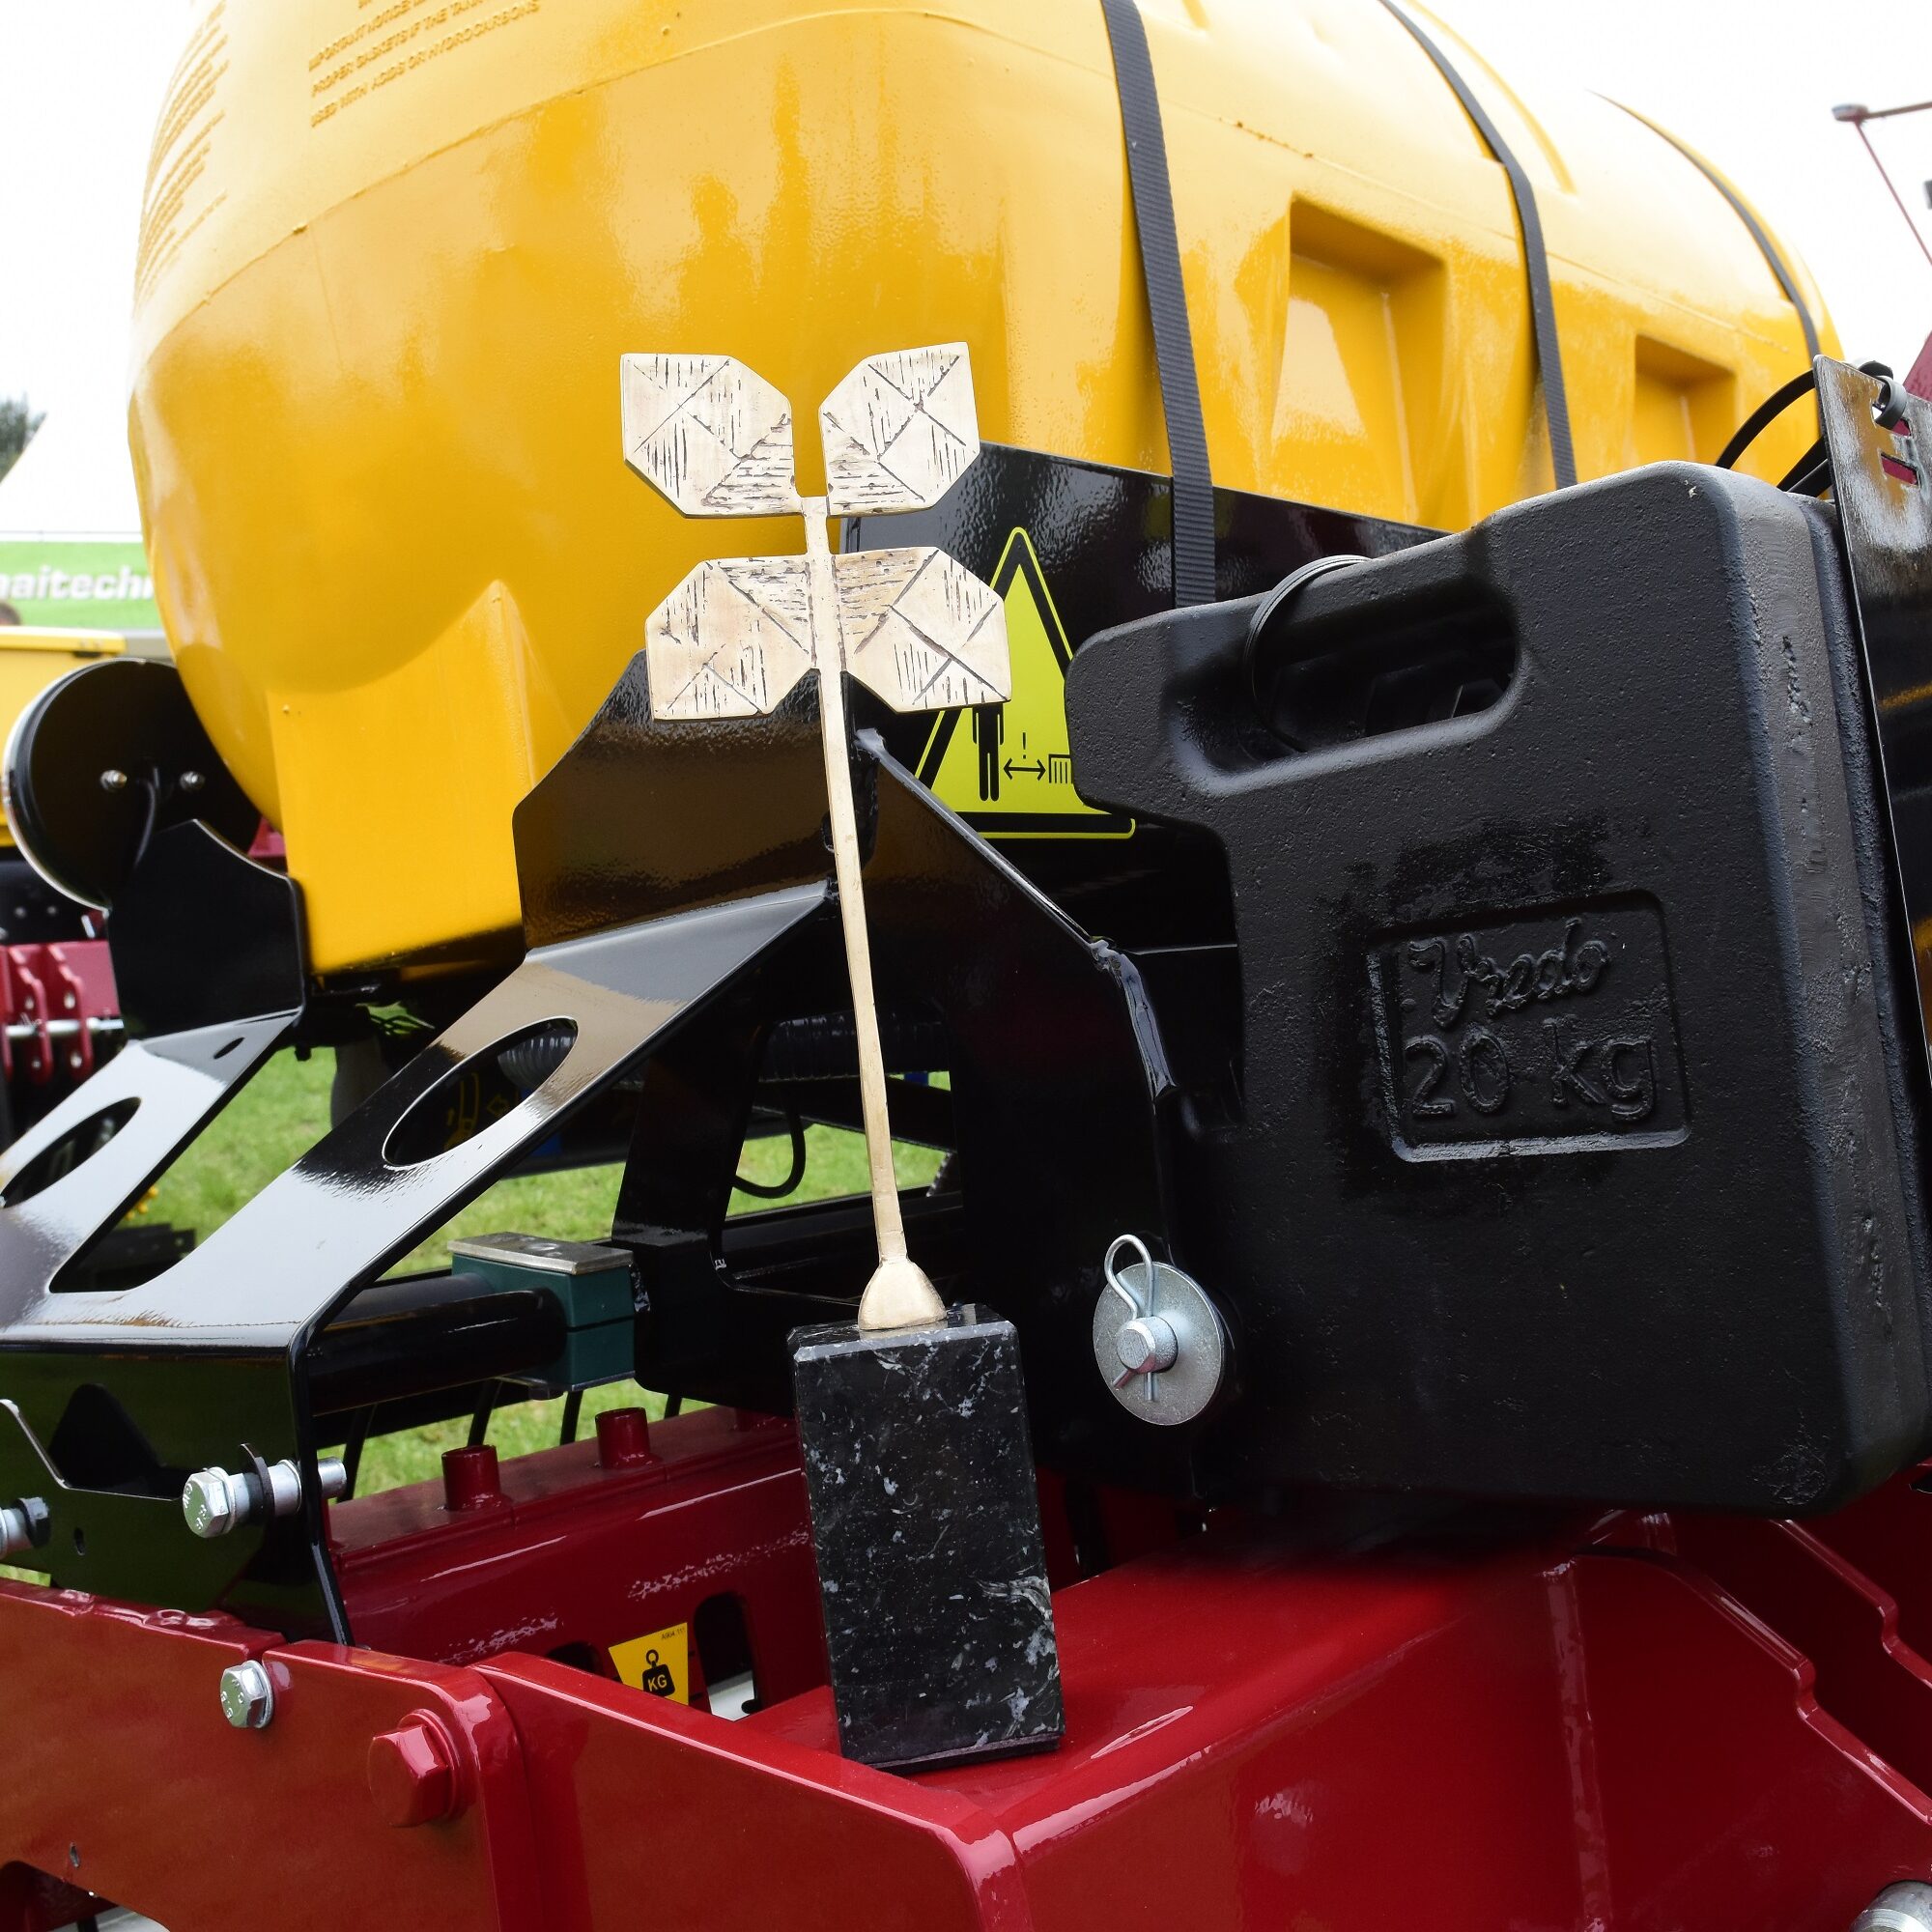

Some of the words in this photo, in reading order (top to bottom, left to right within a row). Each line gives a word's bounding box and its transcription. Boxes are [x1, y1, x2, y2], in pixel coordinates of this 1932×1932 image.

[1406, 917, 1610, 1028] Vredo
[1405, 1021, 1512, 1115] 20
[647, 1674, 668, 1692] KG
